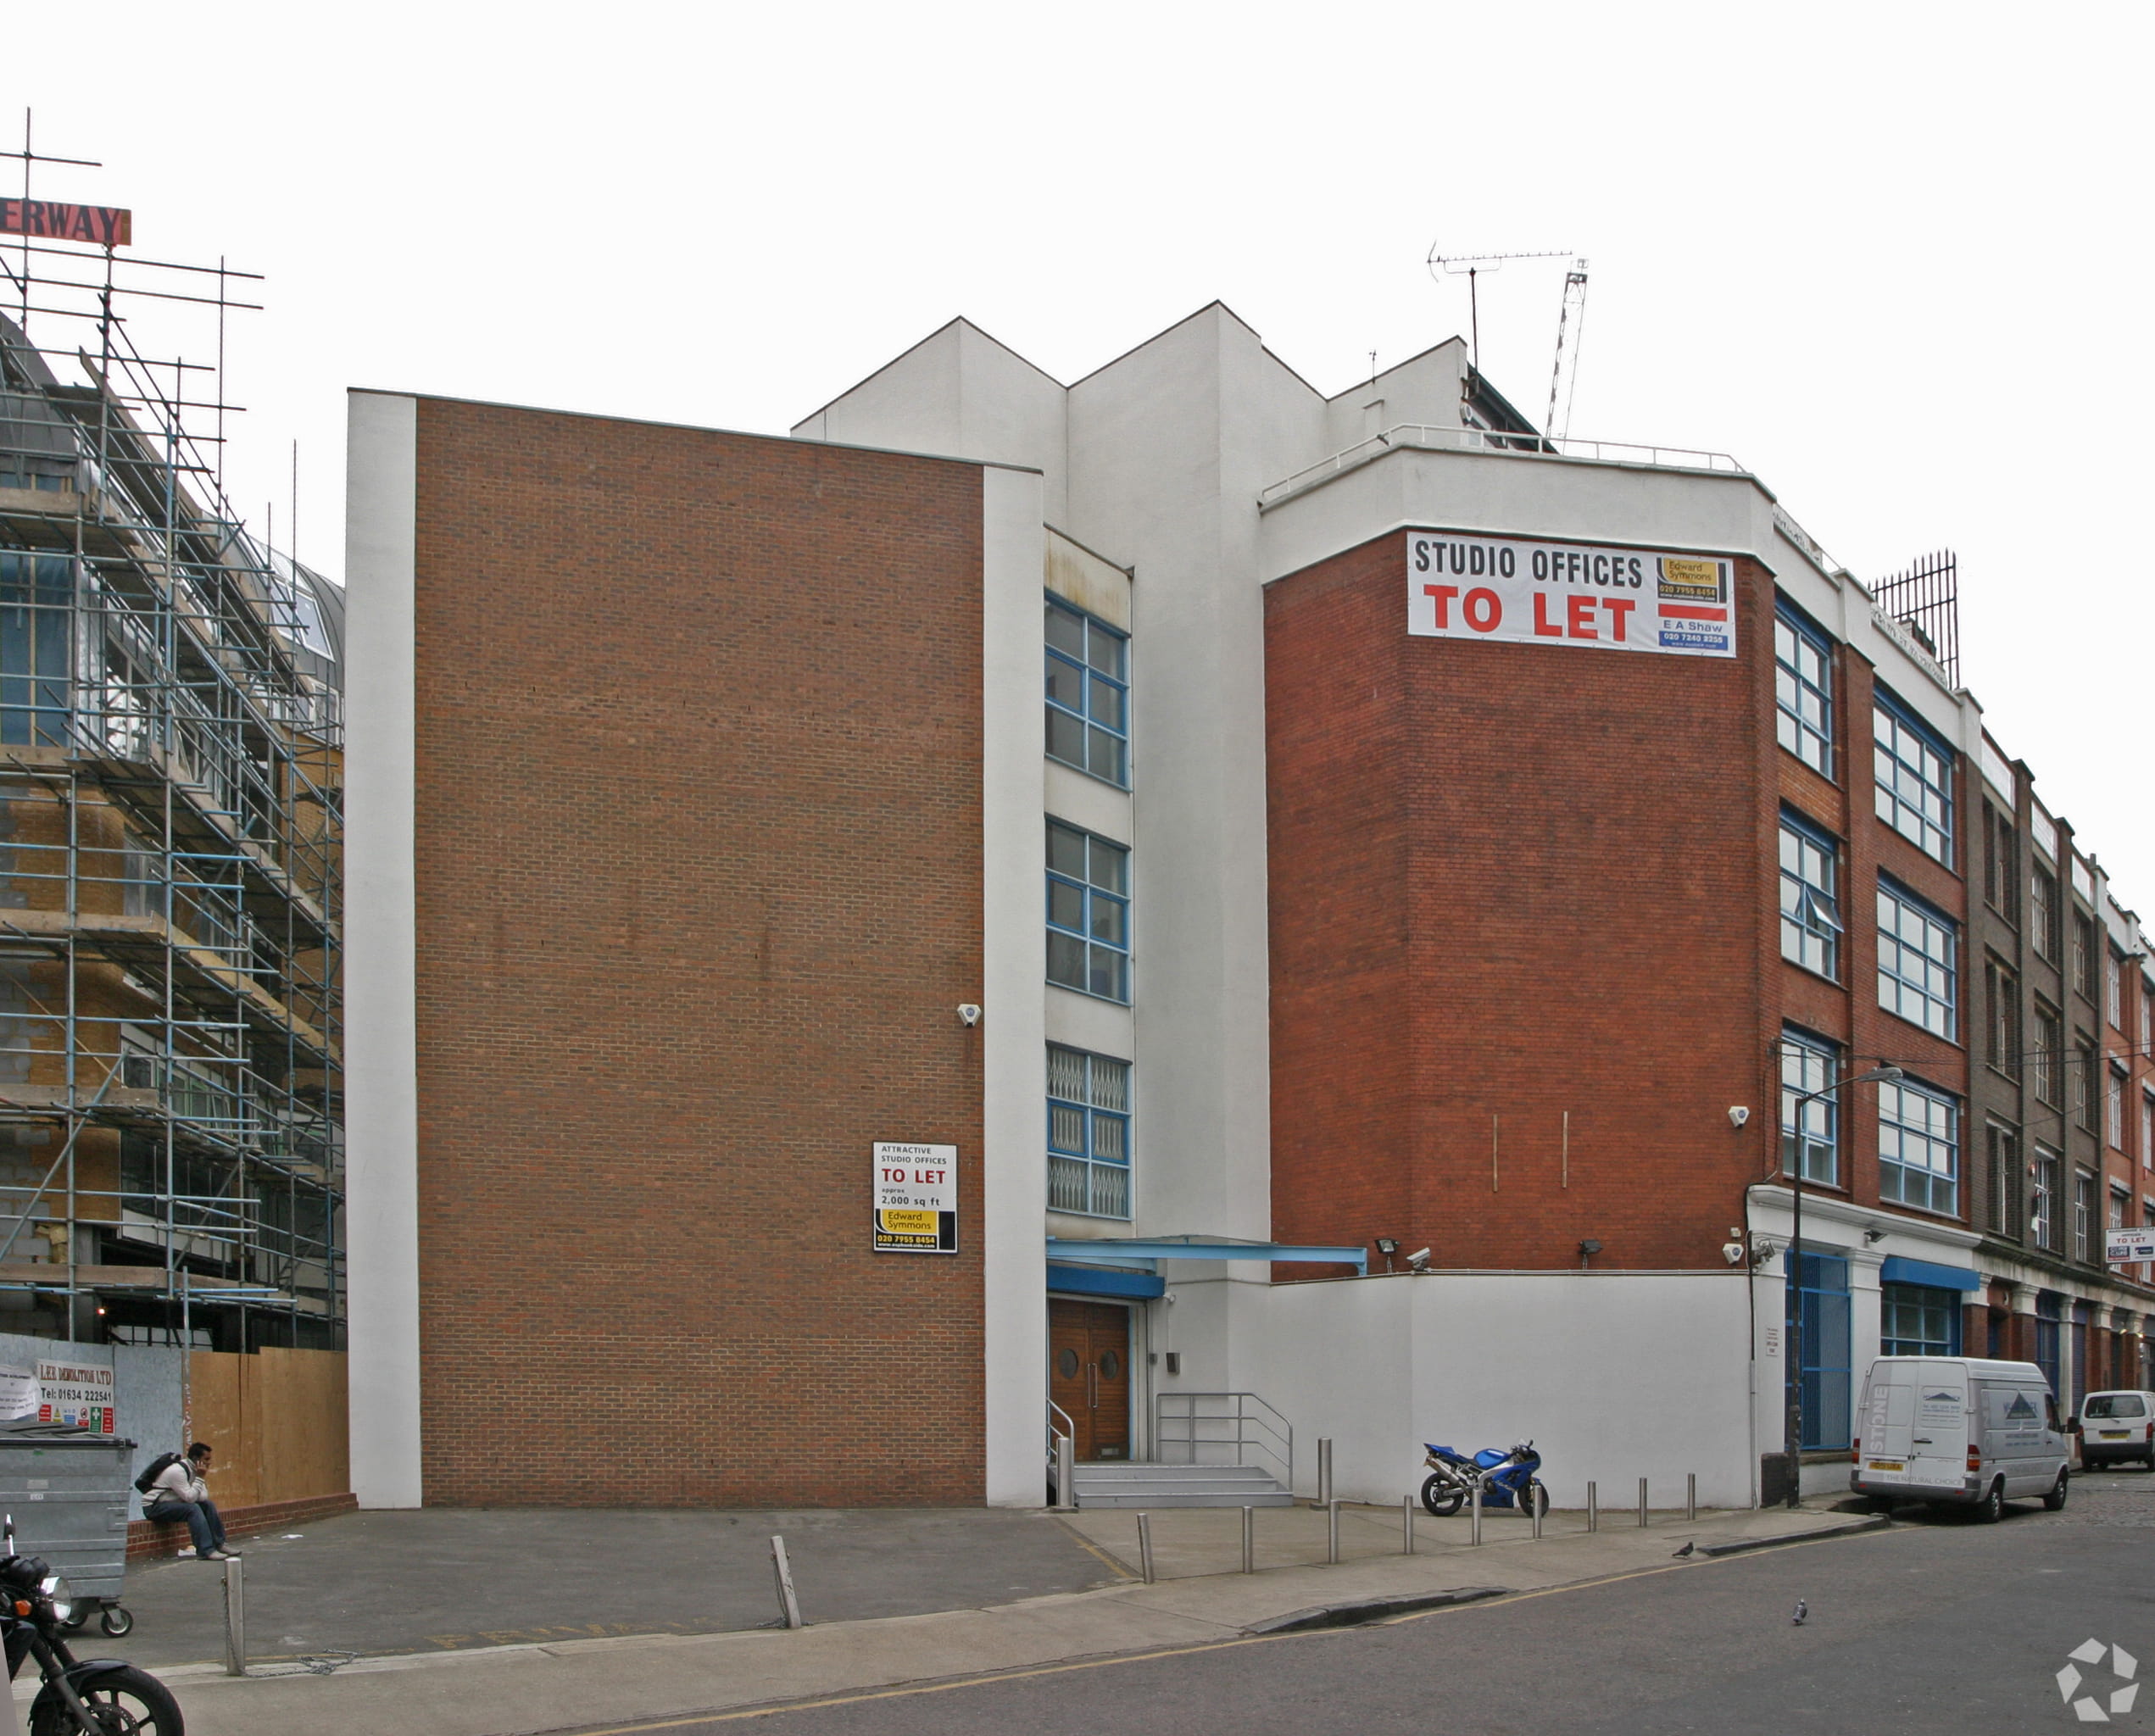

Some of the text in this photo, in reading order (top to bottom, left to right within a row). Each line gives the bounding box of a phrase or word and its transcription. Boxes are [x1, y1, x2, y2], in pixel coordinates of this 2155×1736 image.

[1415, 540, 1642, 589] STUDIO OFFICES
[1669, 561, 1702, 571] Edward
[1669, 570, 1712, 581] Symmons
[1423, 584, 1635, 642] TO LET
[1664, 620, 1723, 632] E A Shaw
[1682, 633, 1701, 642] 7240
[882, 1145, 932, 1155] ATTRACTIVE
[882, 1155, 947, 1165] STUDIO OFFICES
[882, 1168, 946, 1184] TO LET
[882, 1196, 940, 1208] 2,000 sq ft
[888, 1212, 922, 1221] Edward
[888, 1221, 932, 1230] Symmons
[41, 1365, 112, 1386] LEE DEMOLITION LTD
[41, 1388, 112, 1402] Tel: 01634 222541
[1870, 1386, 1888, 1453] STONE
